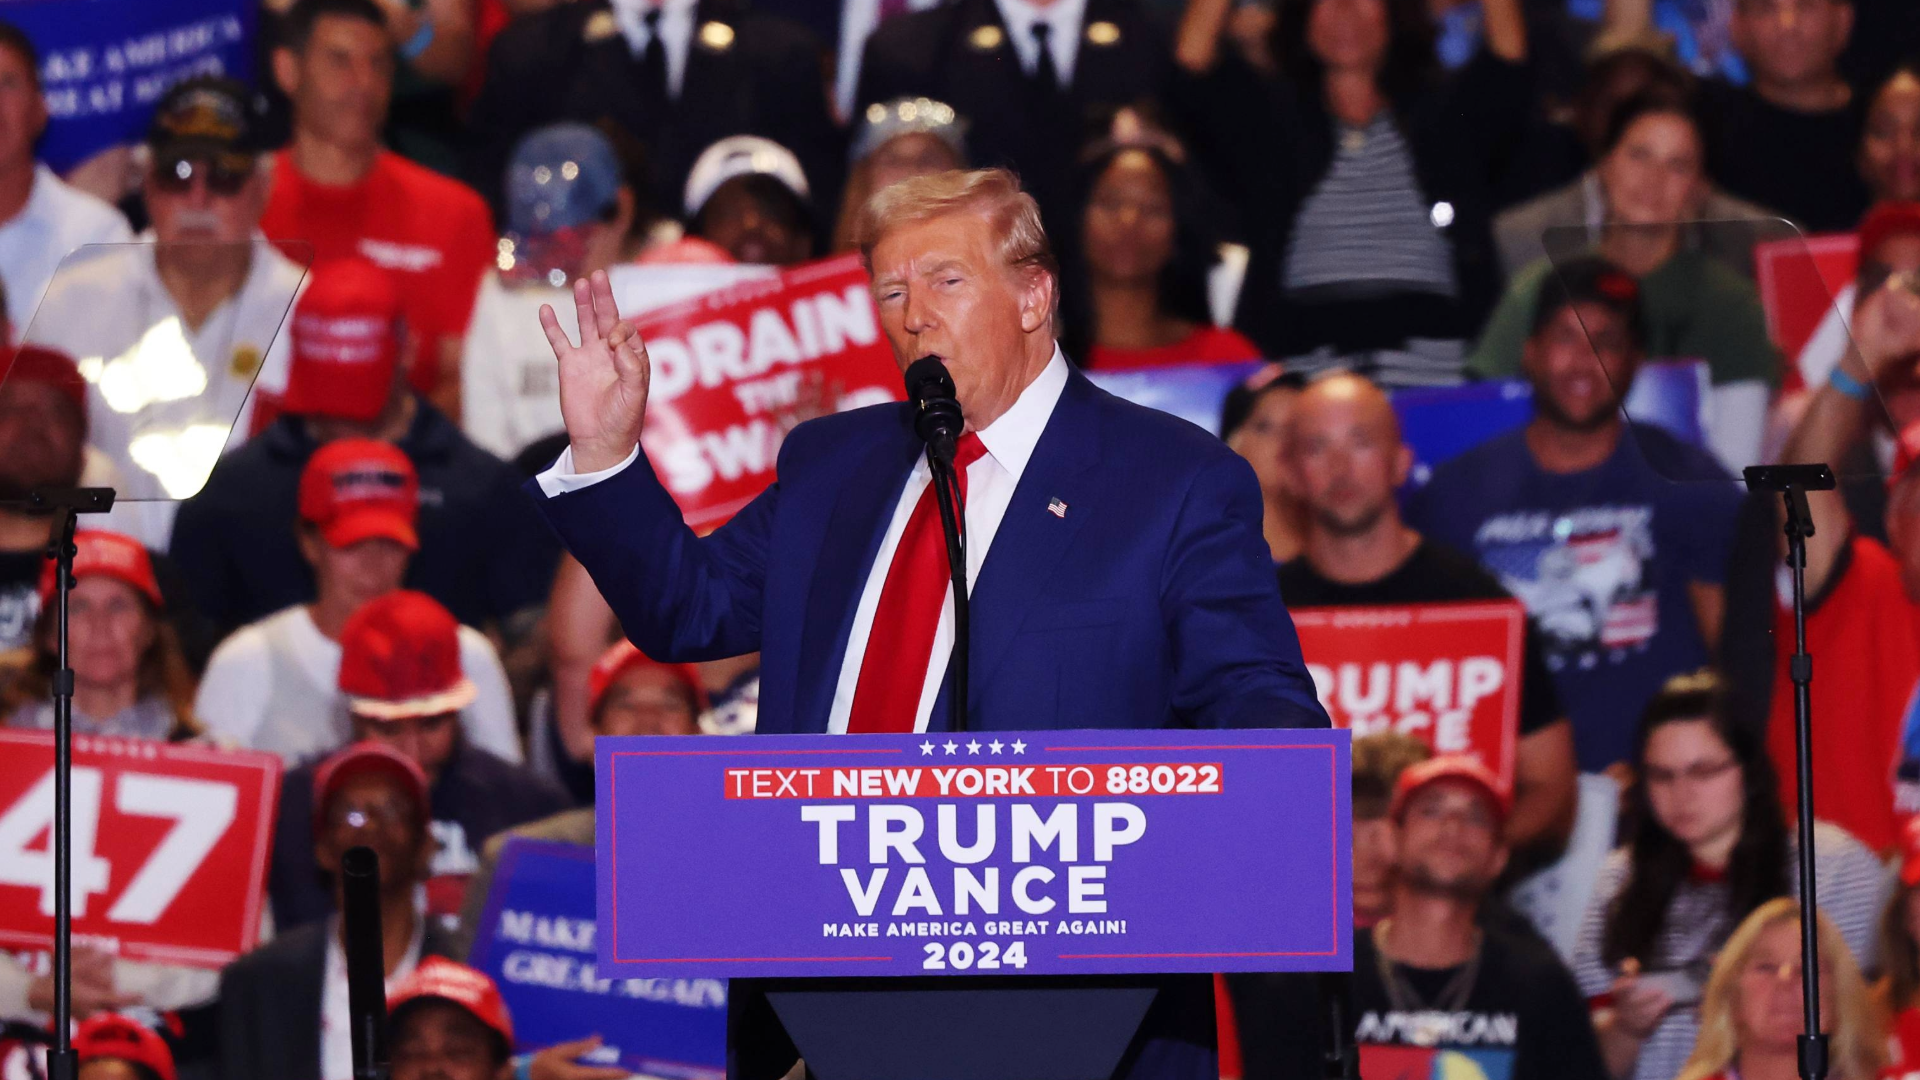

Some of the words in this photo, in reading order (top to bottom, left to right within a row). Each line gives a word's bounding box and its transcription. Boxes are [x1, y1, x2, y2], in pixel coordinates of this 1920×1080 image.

[649, 284, 878, 405] DRAIN
[1304, 655, 1505, 732] RUMP
[728, 769, 821, 798] TEXT
[833, 768, 922, 797] NEW
[931, 767, 1036, 796] YORK
[1045, 766, 1095, 795] TO
[1105, 764, 1219, 794] 88022
[800, 802, 1147, 864] TRUMP
[839, 865, 1107, 916] VANCE
[823, 923, 879, 937] MAKE
[886, 921, 977, 937] AMERICA
[984, 920, 1050, 935] GREAT
[1056, 919, 1127, 935] AGAIN!
[922, 941, 1028, 970] 2024
